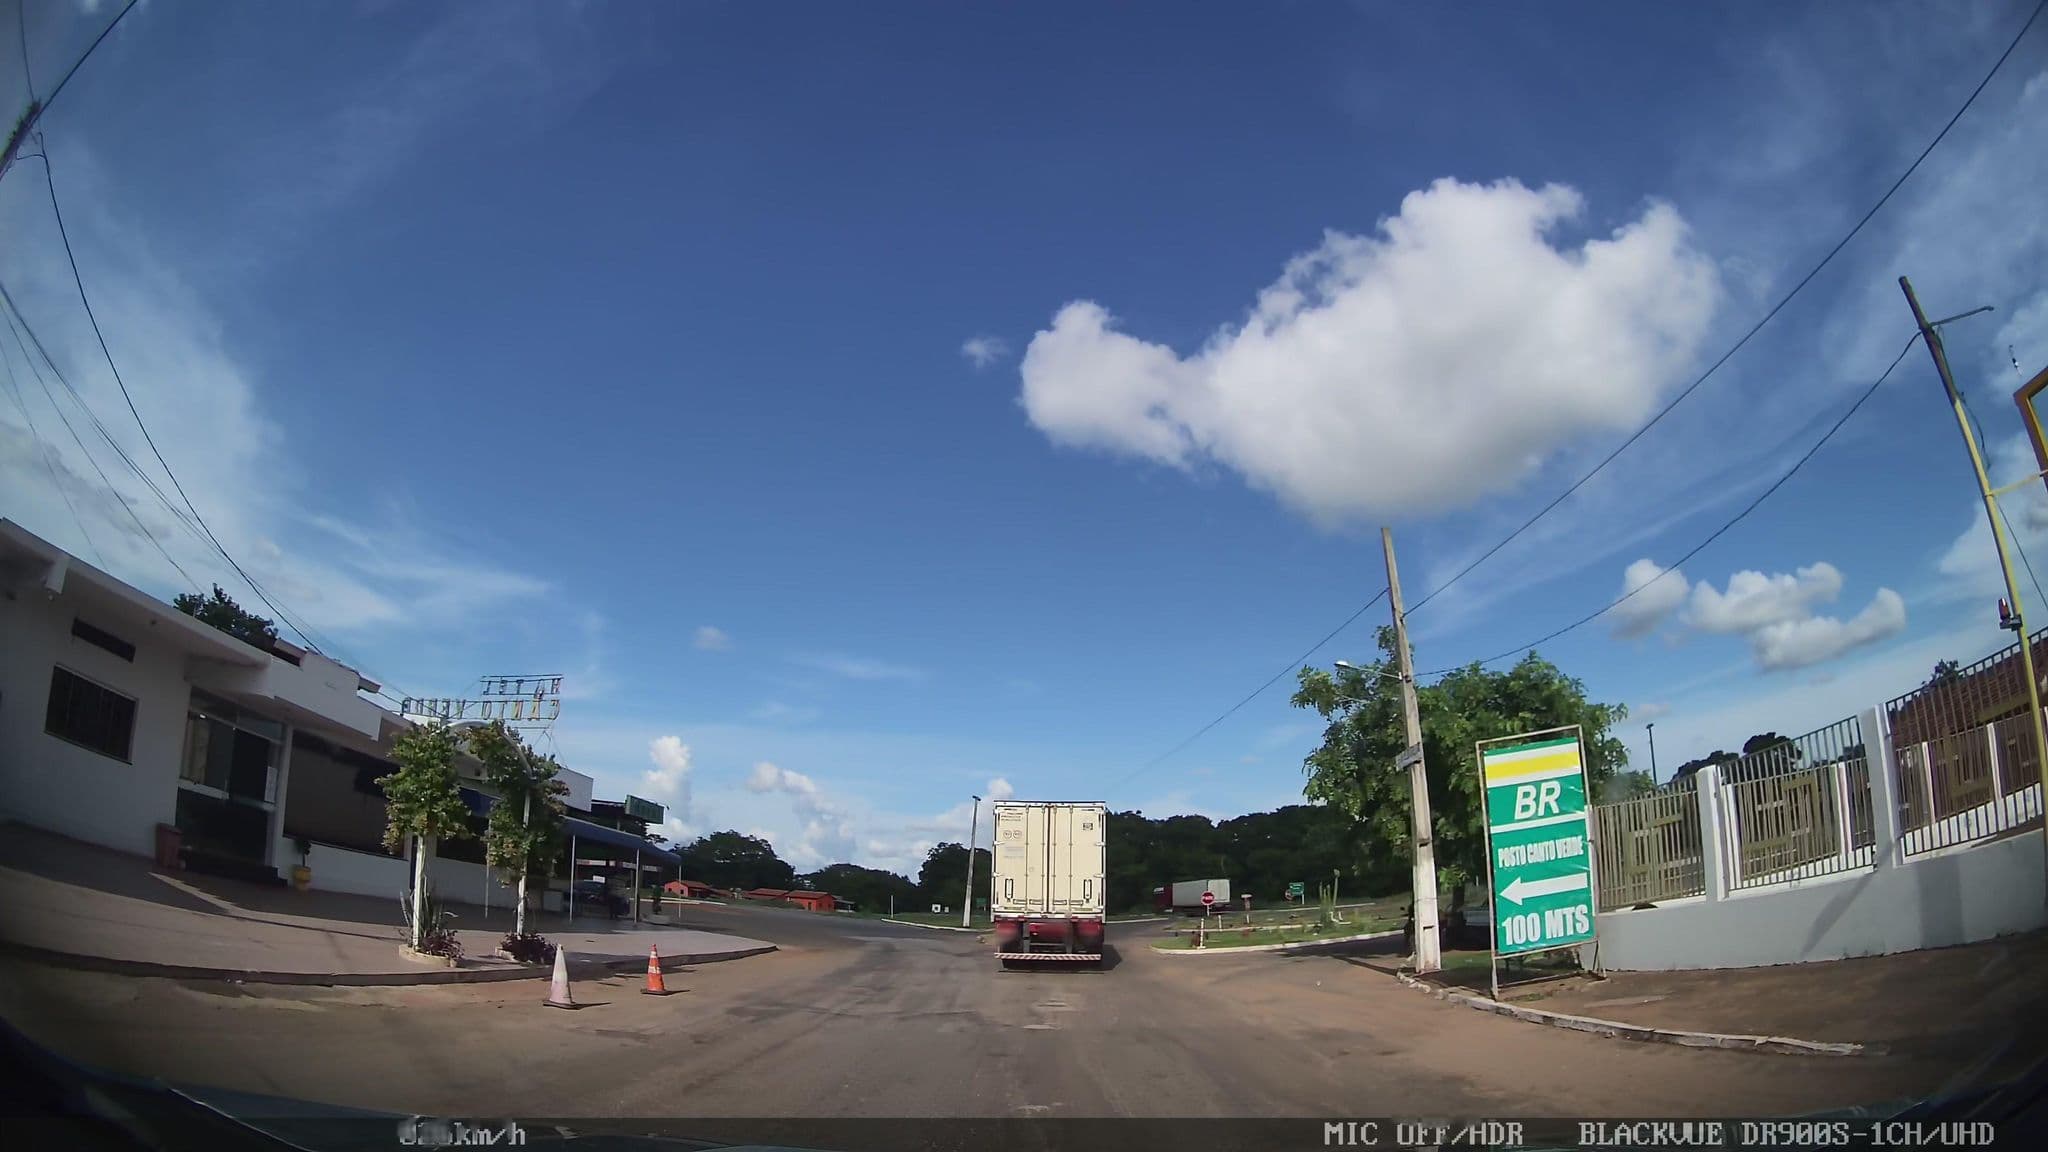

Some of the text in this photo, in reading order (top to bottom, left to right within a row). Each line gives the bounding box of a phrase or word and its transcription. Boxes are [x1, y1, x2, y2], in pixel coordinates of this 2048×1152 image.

[1514, 780, 1561, 820] BR
[1498, 845, 1527, 868] POSTO
[1502, 904, 1589, 946] 100 MTS
